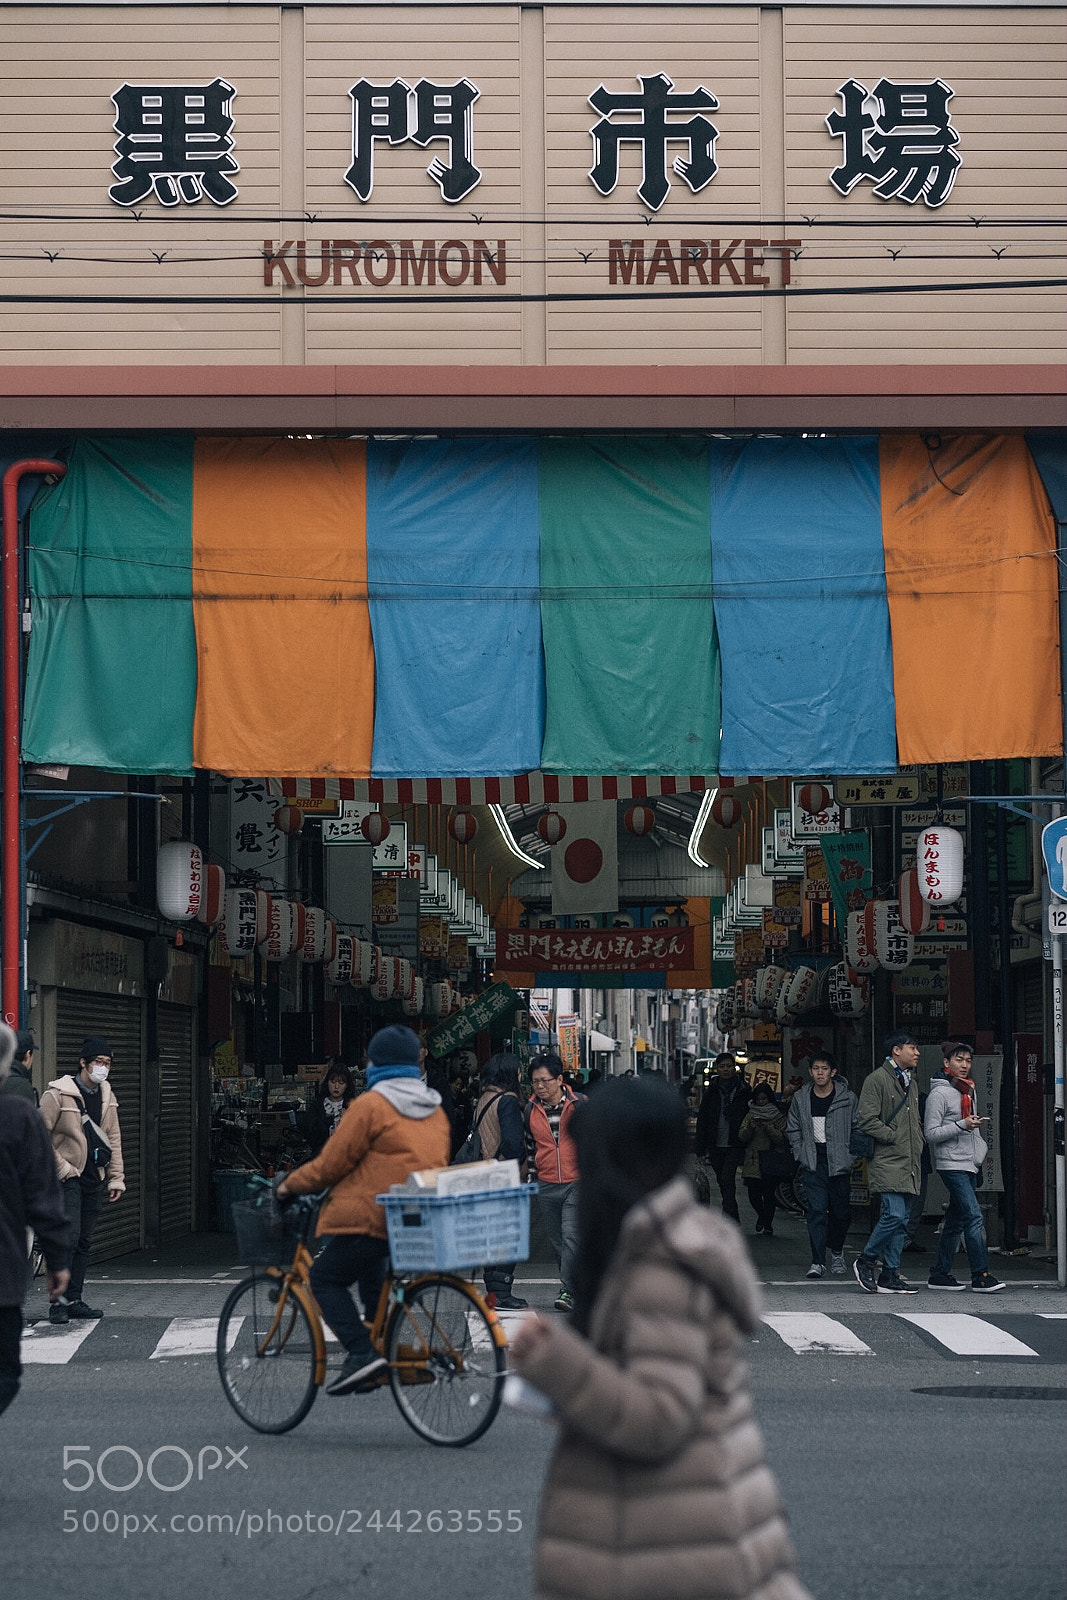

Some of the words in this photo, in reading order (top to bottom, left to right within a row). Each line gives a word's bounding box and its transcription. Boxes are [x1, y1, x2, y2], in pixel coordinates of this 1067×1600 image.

[109, 73, 963, 211] 黒門市場
[263, 239, 507, 286] KUROMON
[608, 239, 803, 286] MARKET
[296, 799, 323, 808] SHOP
[186, 849, 201, 915] なにわの台所
[924, 833, 943, 900] ほんまもん
[236, 892, 256, 950] 黒門市場
[901, 974, 947, 988] 世界の食
